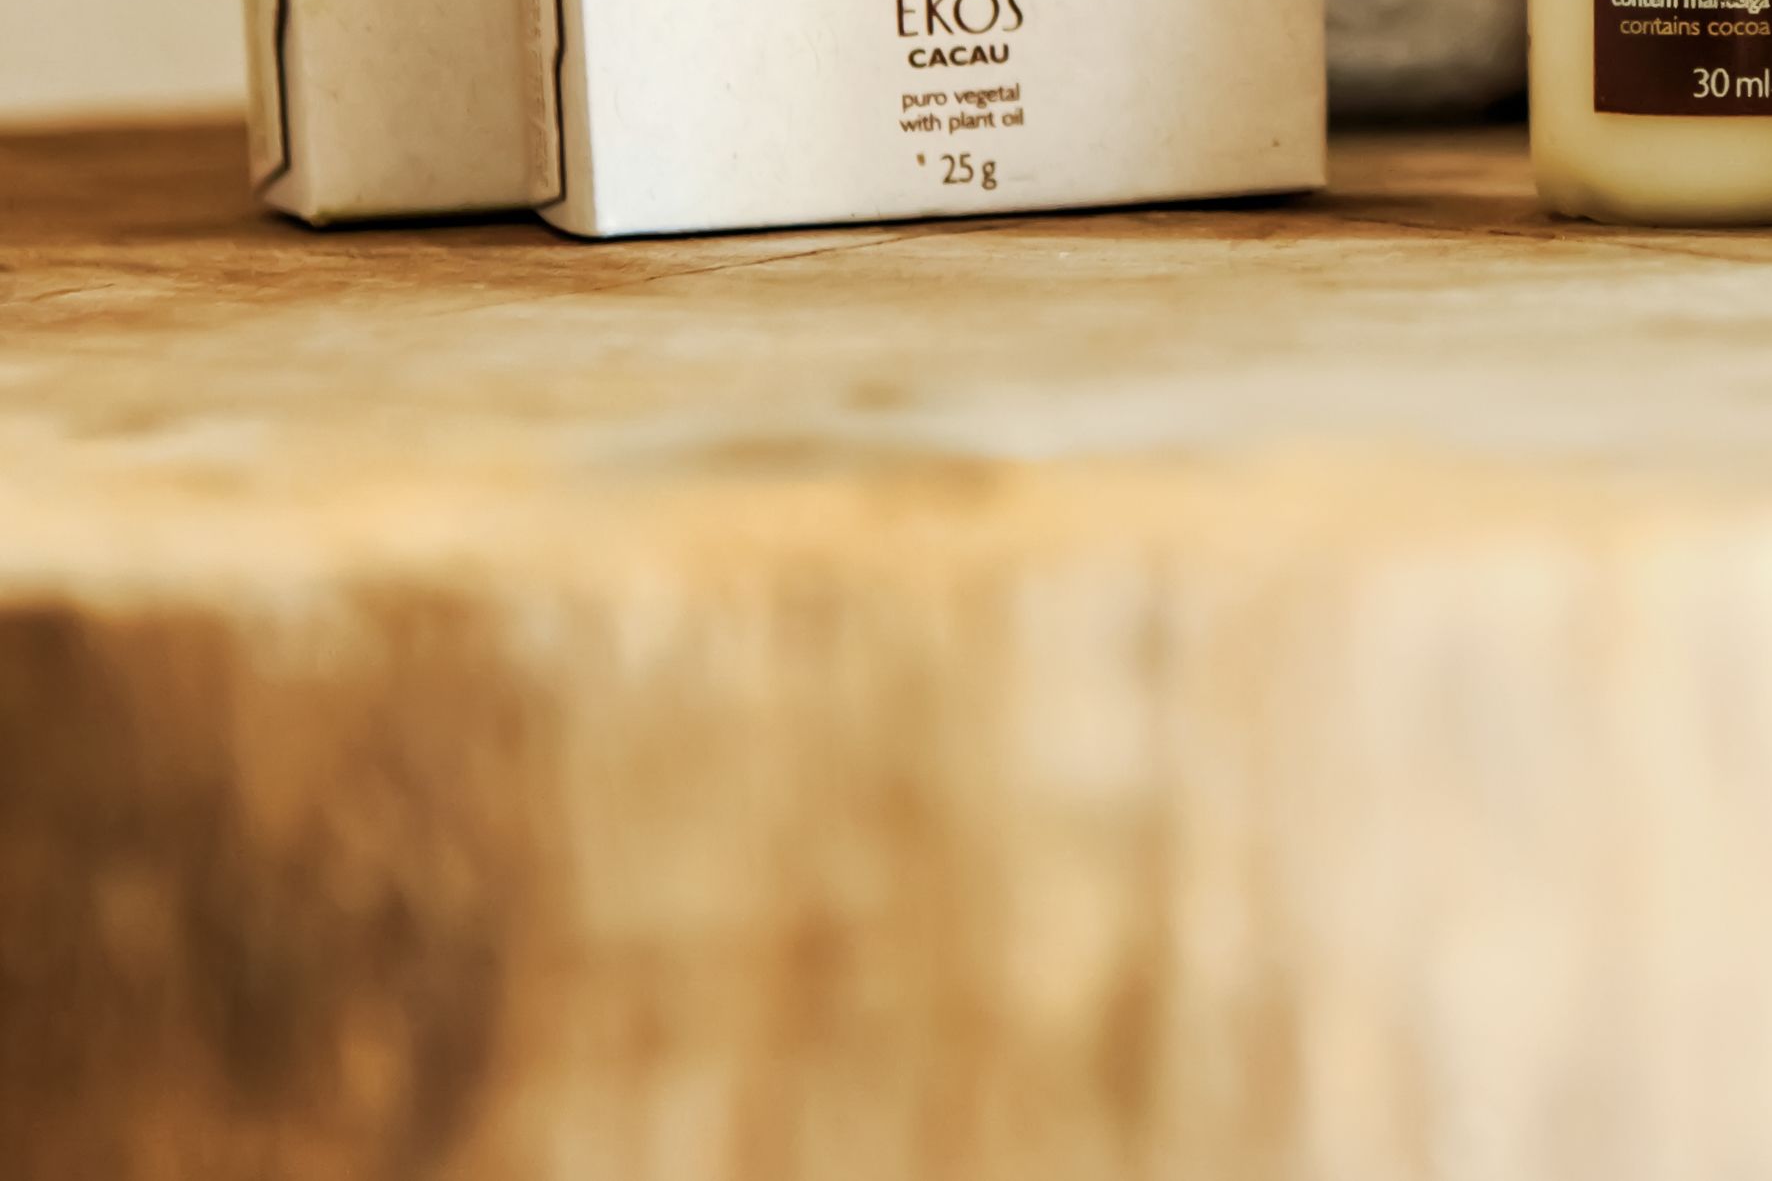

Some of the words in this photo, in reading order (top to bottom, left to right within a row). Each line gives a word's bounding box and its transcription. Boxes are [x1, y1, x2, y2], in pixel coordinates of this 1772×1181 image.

[1620, 16, 1700, 36] contains
[1707, 21, 1770, 36] cocoa
[908, 44, 1009, 69] CACAU
[1692, 68, 1729, 98] 30
[1736, 68, 1770, 98] ml
[902, 92, 947, 114] puro
[954, 82, 1020, 108] vegetal
[899, 113, 941, 133] with
[949, 110, 995, 134] plant
[1002, 107, 1024, 127] oil
[941, 153, 974, 185] 25
[981, 160, 997, 190] g
